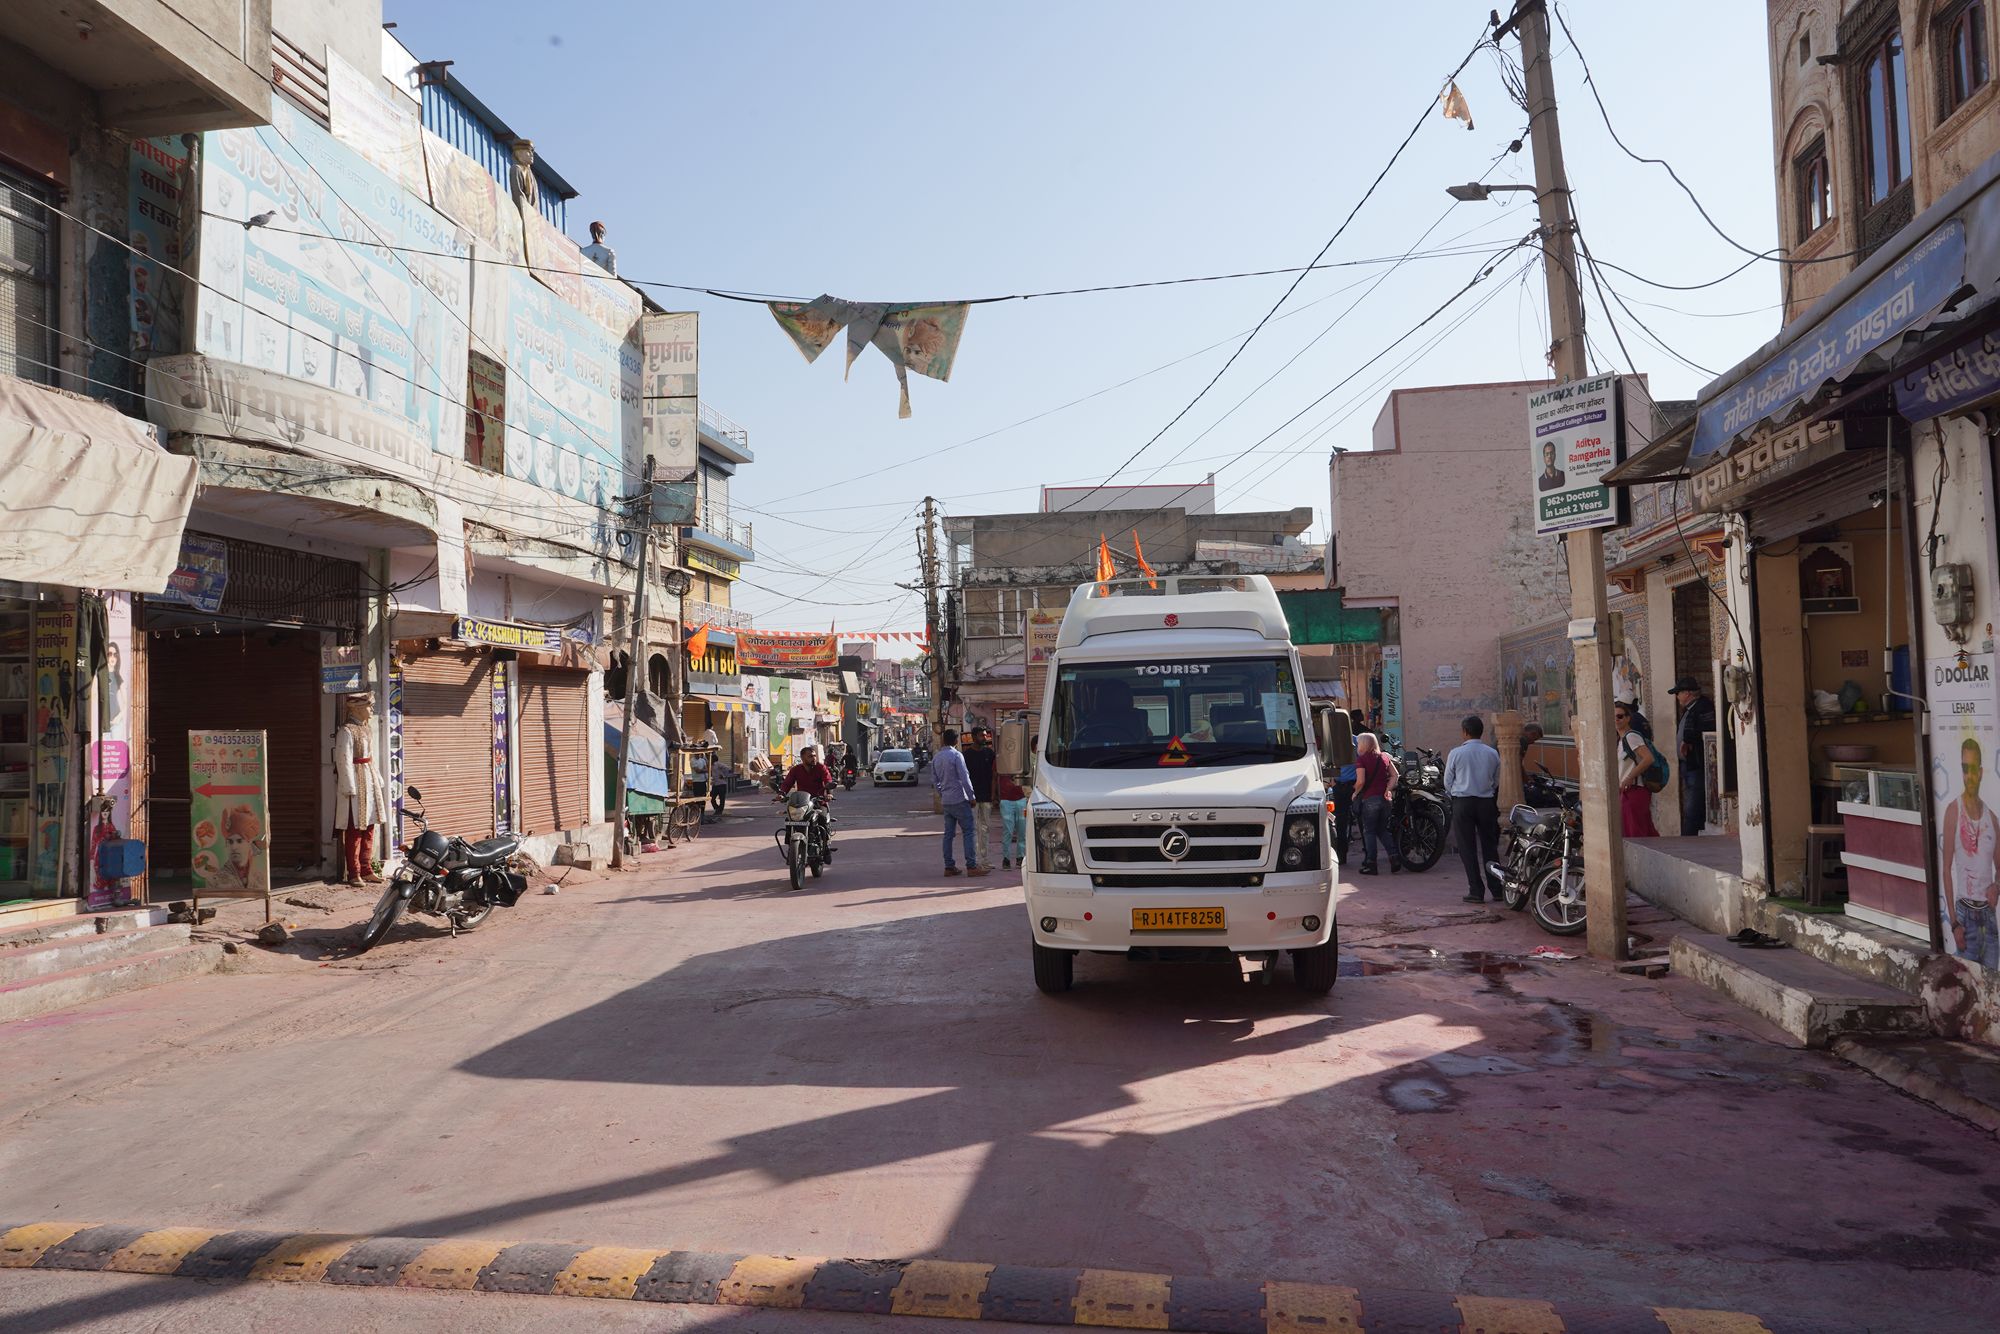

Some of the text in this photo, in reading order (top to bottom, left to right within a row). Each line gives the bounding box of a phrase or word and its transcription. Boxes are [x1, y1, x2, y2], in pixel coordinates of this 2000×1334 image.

[1723, 386, 1755, 433] मोदी
[1845, 281, 1915, 355] मण्डावा
[1531, 377, 1612, 408] MATRIX NEET
[1566, 417, 1582, 425] College
[1584, 412, 1603, 421] Silchar
[1575, 437, 1601, 450] Aditya
[1568, 447, 1611, 463] Ramgarhia
[1546, 489, 1599, 506] 962+ Doctors
[1545, 500, 1603, 517] in Last 2 Years
[487, 625, 521, 645] FASHION
[522, 629, 545, 646] POINT
[1134, 664, 1211, 676] TOURIST
[1945, 664, 1989, 683] DOLLAR
[1952, 702, 1975, 714] LEHAR
[213, 735, 261, 745] 9413524336
[1132, 811, 1217, 821] FORCE
[1142, 911, 1222, 926] RJ14TF8258
